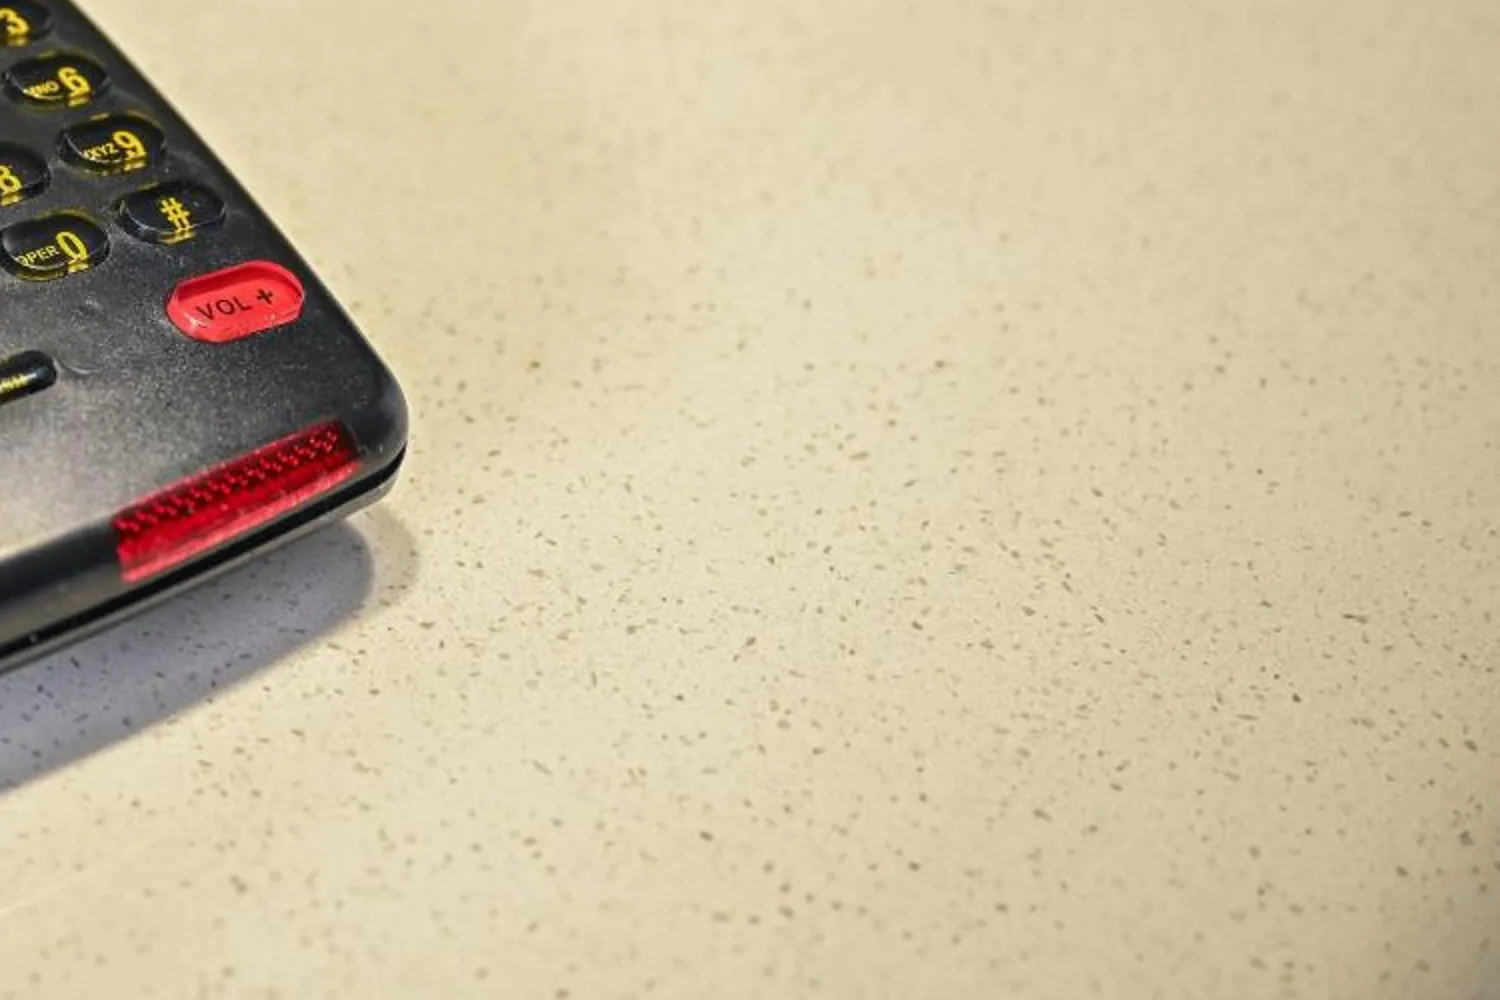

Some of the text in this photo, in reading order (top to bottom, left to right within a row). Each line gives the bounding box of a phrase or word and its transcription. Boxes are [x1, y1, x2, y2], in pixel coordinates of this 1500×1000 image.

[57, 66, 92, 97] 6
[112, 130, 147, 160] 9
[160, 197, 192, 230] #
[54, 231, 89, 262] 0
[196, 288, 274, 321] VOL +
